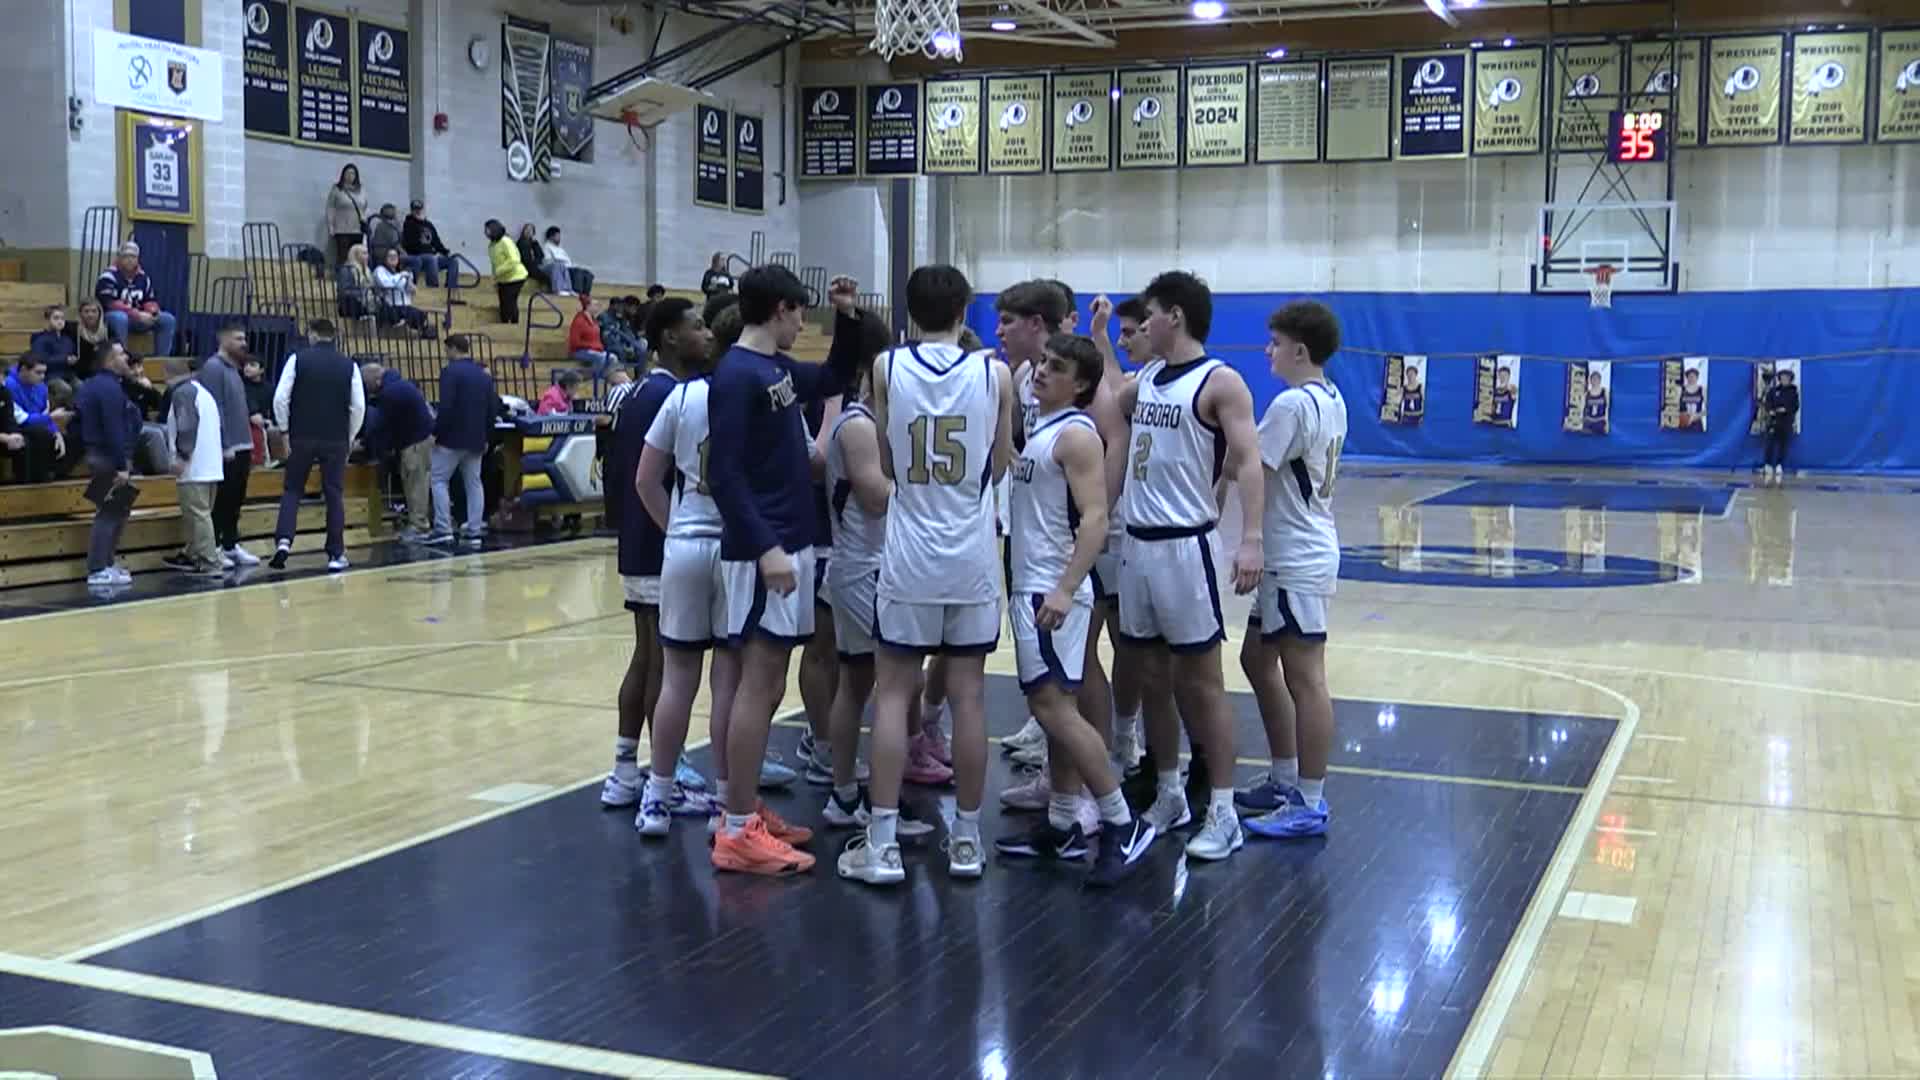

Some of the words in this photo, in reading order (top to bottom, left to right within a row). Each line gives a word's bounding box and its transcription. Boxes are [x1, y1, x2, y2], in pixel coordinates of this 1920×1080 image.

[1717, 48, 1776, 58] WRESTLING
[1800, 45, 1861, 55] WRESTLING
[1482, 61, 1537, 70] WRESTLING
[1192, 73, 1243, 86] FOXBORO
[1195, 107, 1238, 124] 2024
[1811, 114, 1844, 123] STATE
[1727, 117, 1759, 126] STATE
[1492, 126, 1521, 135] STATE
[1710, 127, 1776, 137] CHAMPIONS
[1793, 126, 1861, 136] CHAMPIONS
[1136, 142, 1161, 150] STATE
[1477, 138, 1537, 148] CHAMPIONS
[1621, 130, 1655, 159] 35
[1069, 145, 1093, 153] STATE
[1190, 148, 1242, 159] CHAMPIONS
[1056, 156, 1107, 164] CHAMPIONS
[1123, 152, 1175, 161] CHAMPIONS
[991, 158, 1040, 167] CHAMPIONS
[153, 163, 171, 182] 33
[541, 421, 570, 433] HOME
[574, 420, 587, 432] OF
[908, 415, 967, 486] 15
[1133, 432, 1152, 481] 2
